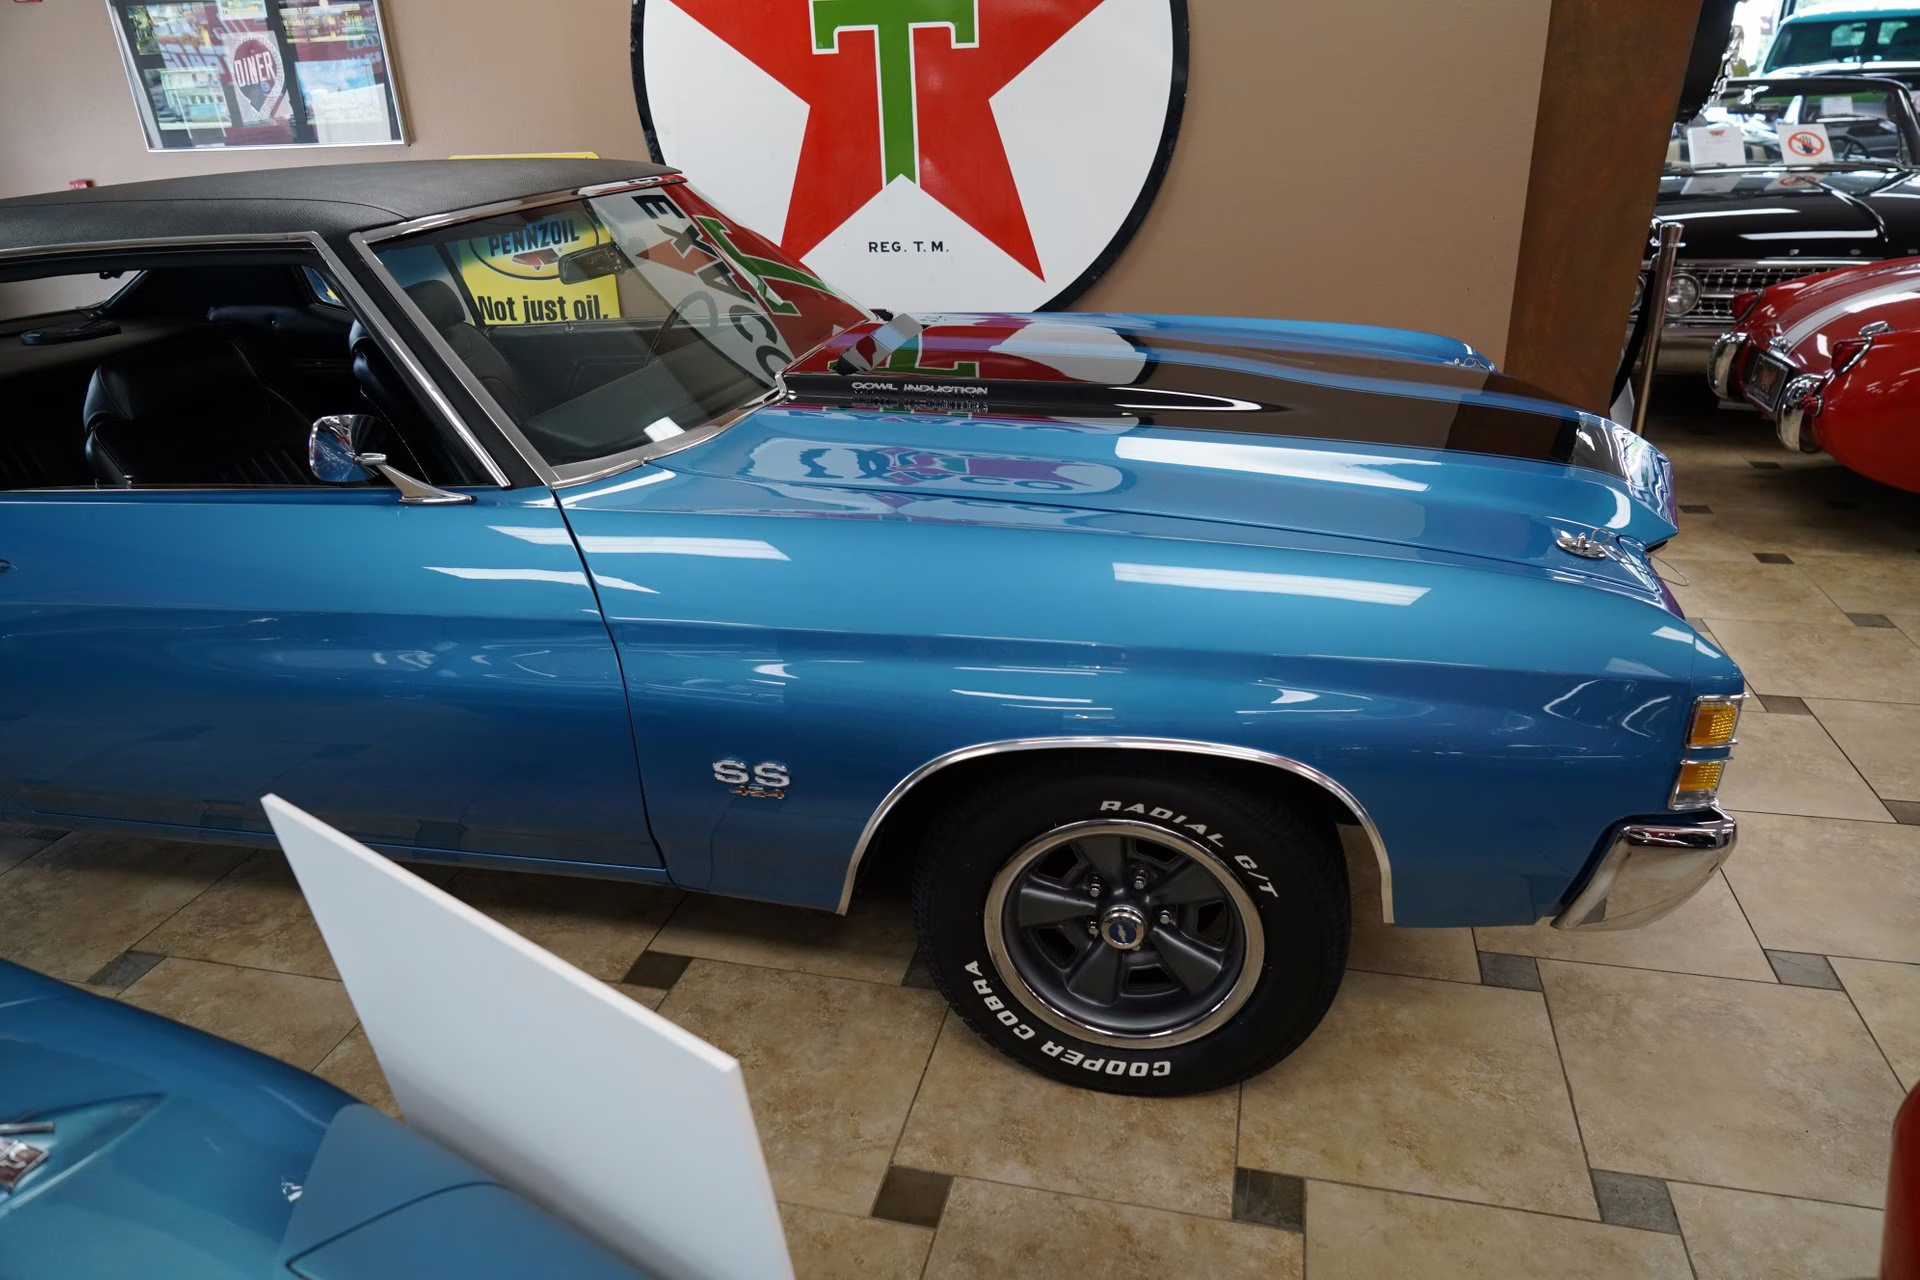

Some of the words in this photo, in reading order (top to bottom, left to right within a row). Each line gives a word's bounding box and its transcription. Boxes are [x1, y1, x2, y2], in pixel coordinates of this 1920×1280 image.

[809, 0, 979, 189] T
[488, 218, 580, 257] PENNZOIL
[868, 241, 907, 253] REG.
[477, 295, 517, 321] Not
[522, 295, 568, 324] just
[573, 294, 608, 321] oil.
[851, 381, 899, 391] COWL
[903, 383, 989, 395] INDUCTION
[712, 759, 791, 788] SS
[1099, 800, 1224, 848] RADIAL
[1234, 855, 1279, 898] G/T
[964, 960, 1036, 1040] COBRA
[1040, 1040, 1171, 1077] COOPER
